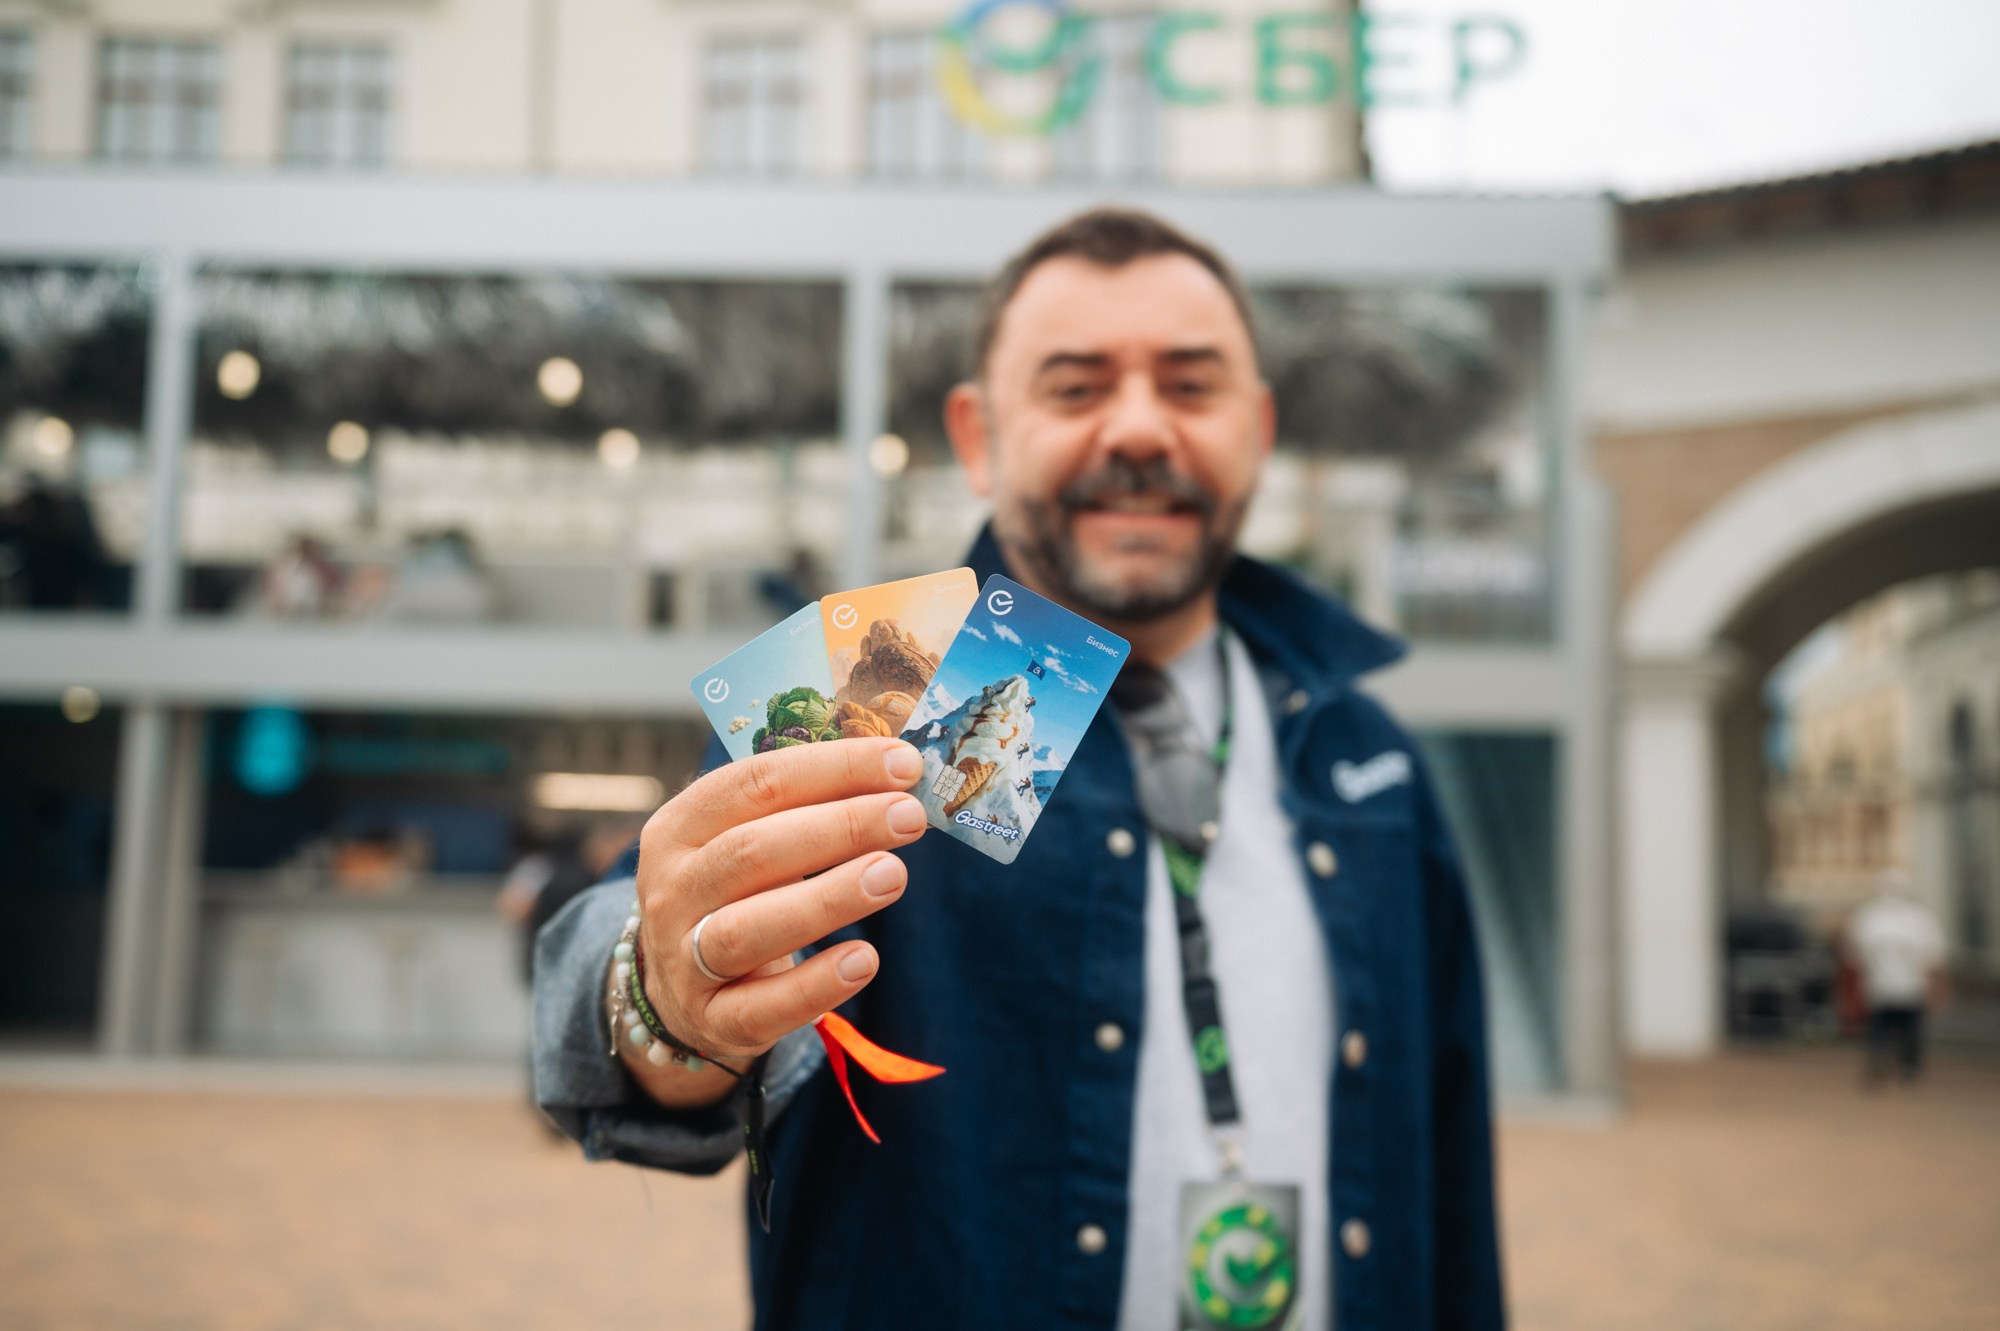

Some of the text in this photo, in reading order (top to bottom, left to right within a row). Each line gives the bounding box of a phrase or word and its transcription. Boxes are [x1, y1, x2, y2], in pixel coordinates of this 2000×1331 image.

[1145, 12, 1529, 106] СБЕР
[1086, 635, 1119, 658] Бизнес
[955, 810, 1019, 840] Gastreet
